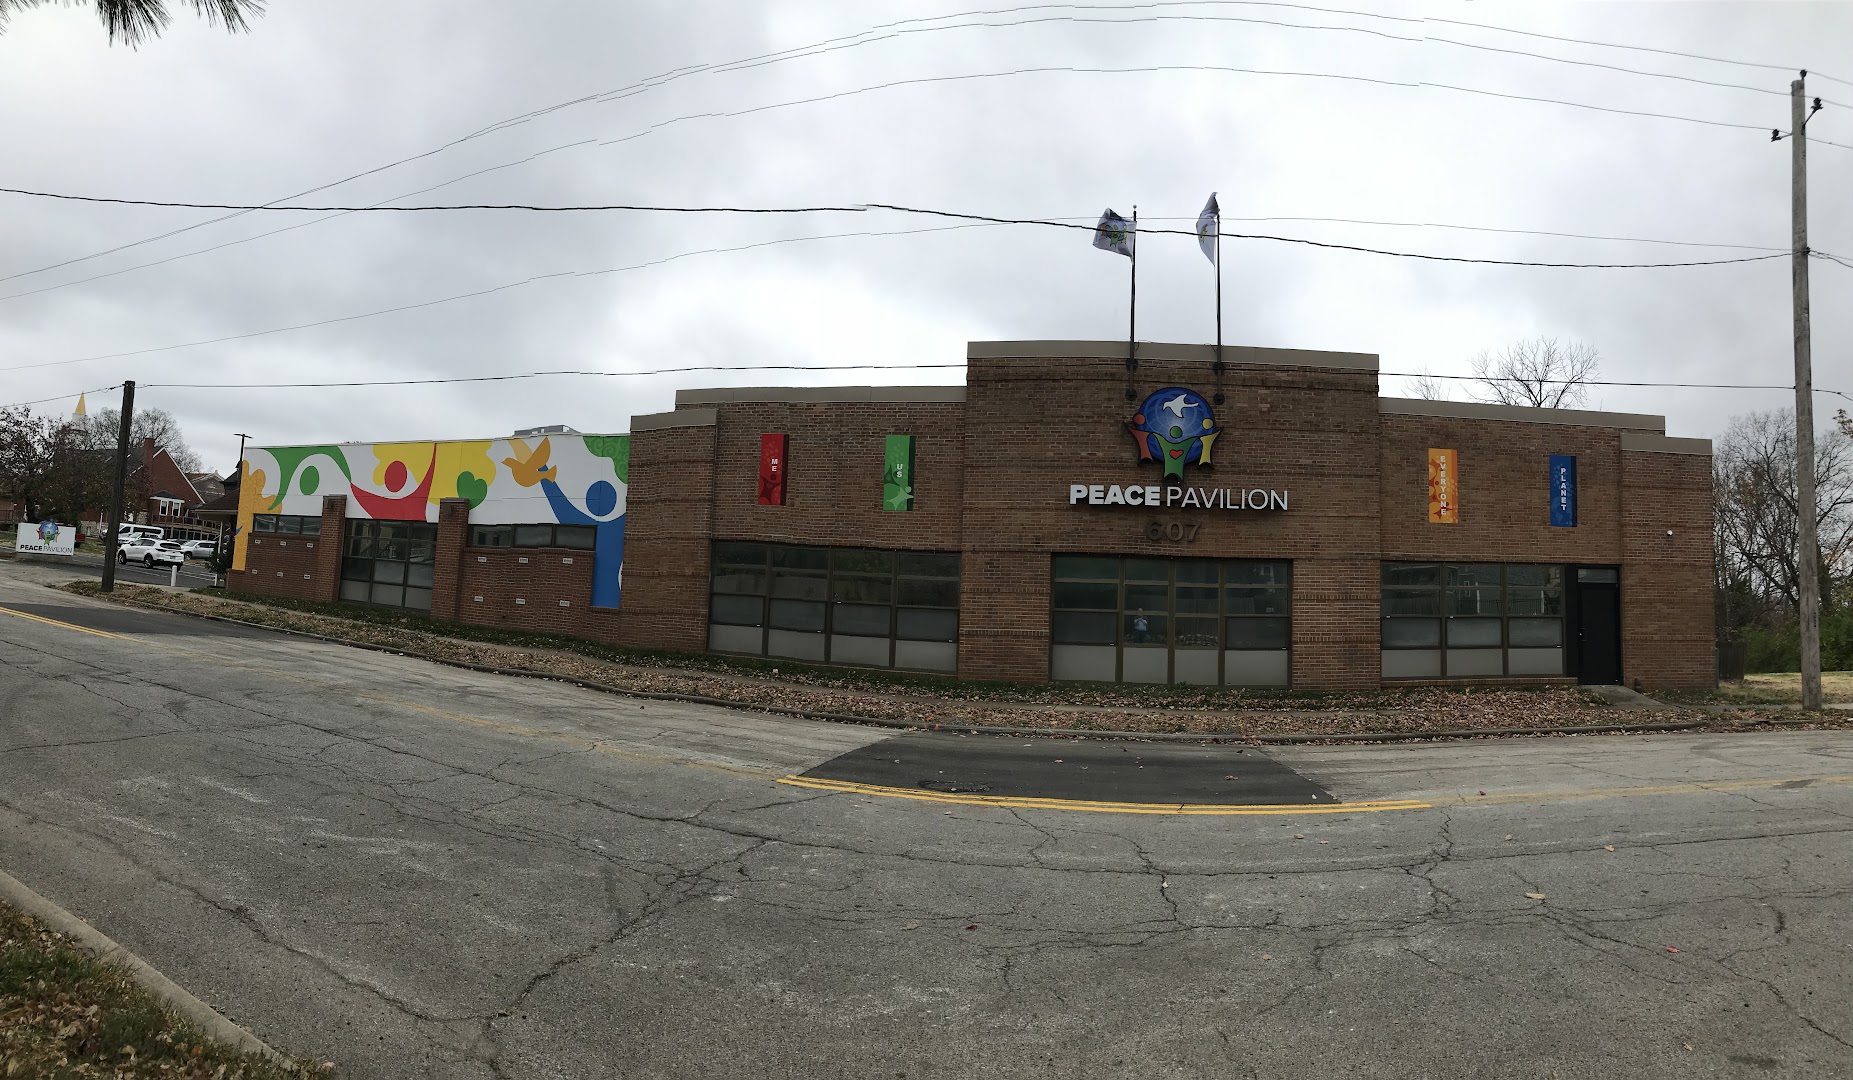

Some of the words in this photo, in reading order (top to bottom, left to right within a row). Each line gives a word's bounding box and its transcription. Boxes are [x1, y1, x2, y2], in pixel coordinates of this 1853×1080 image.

[771, 458, 779, 472] ME
[896, 463, 904, 478] US
[1069, 484, 1161, 507] PEACE
[1166, 486, 1288, 511] PAVILION
[1147, 520, 1202, 542] 607
[43, 545, 73, 553] PAVILION
